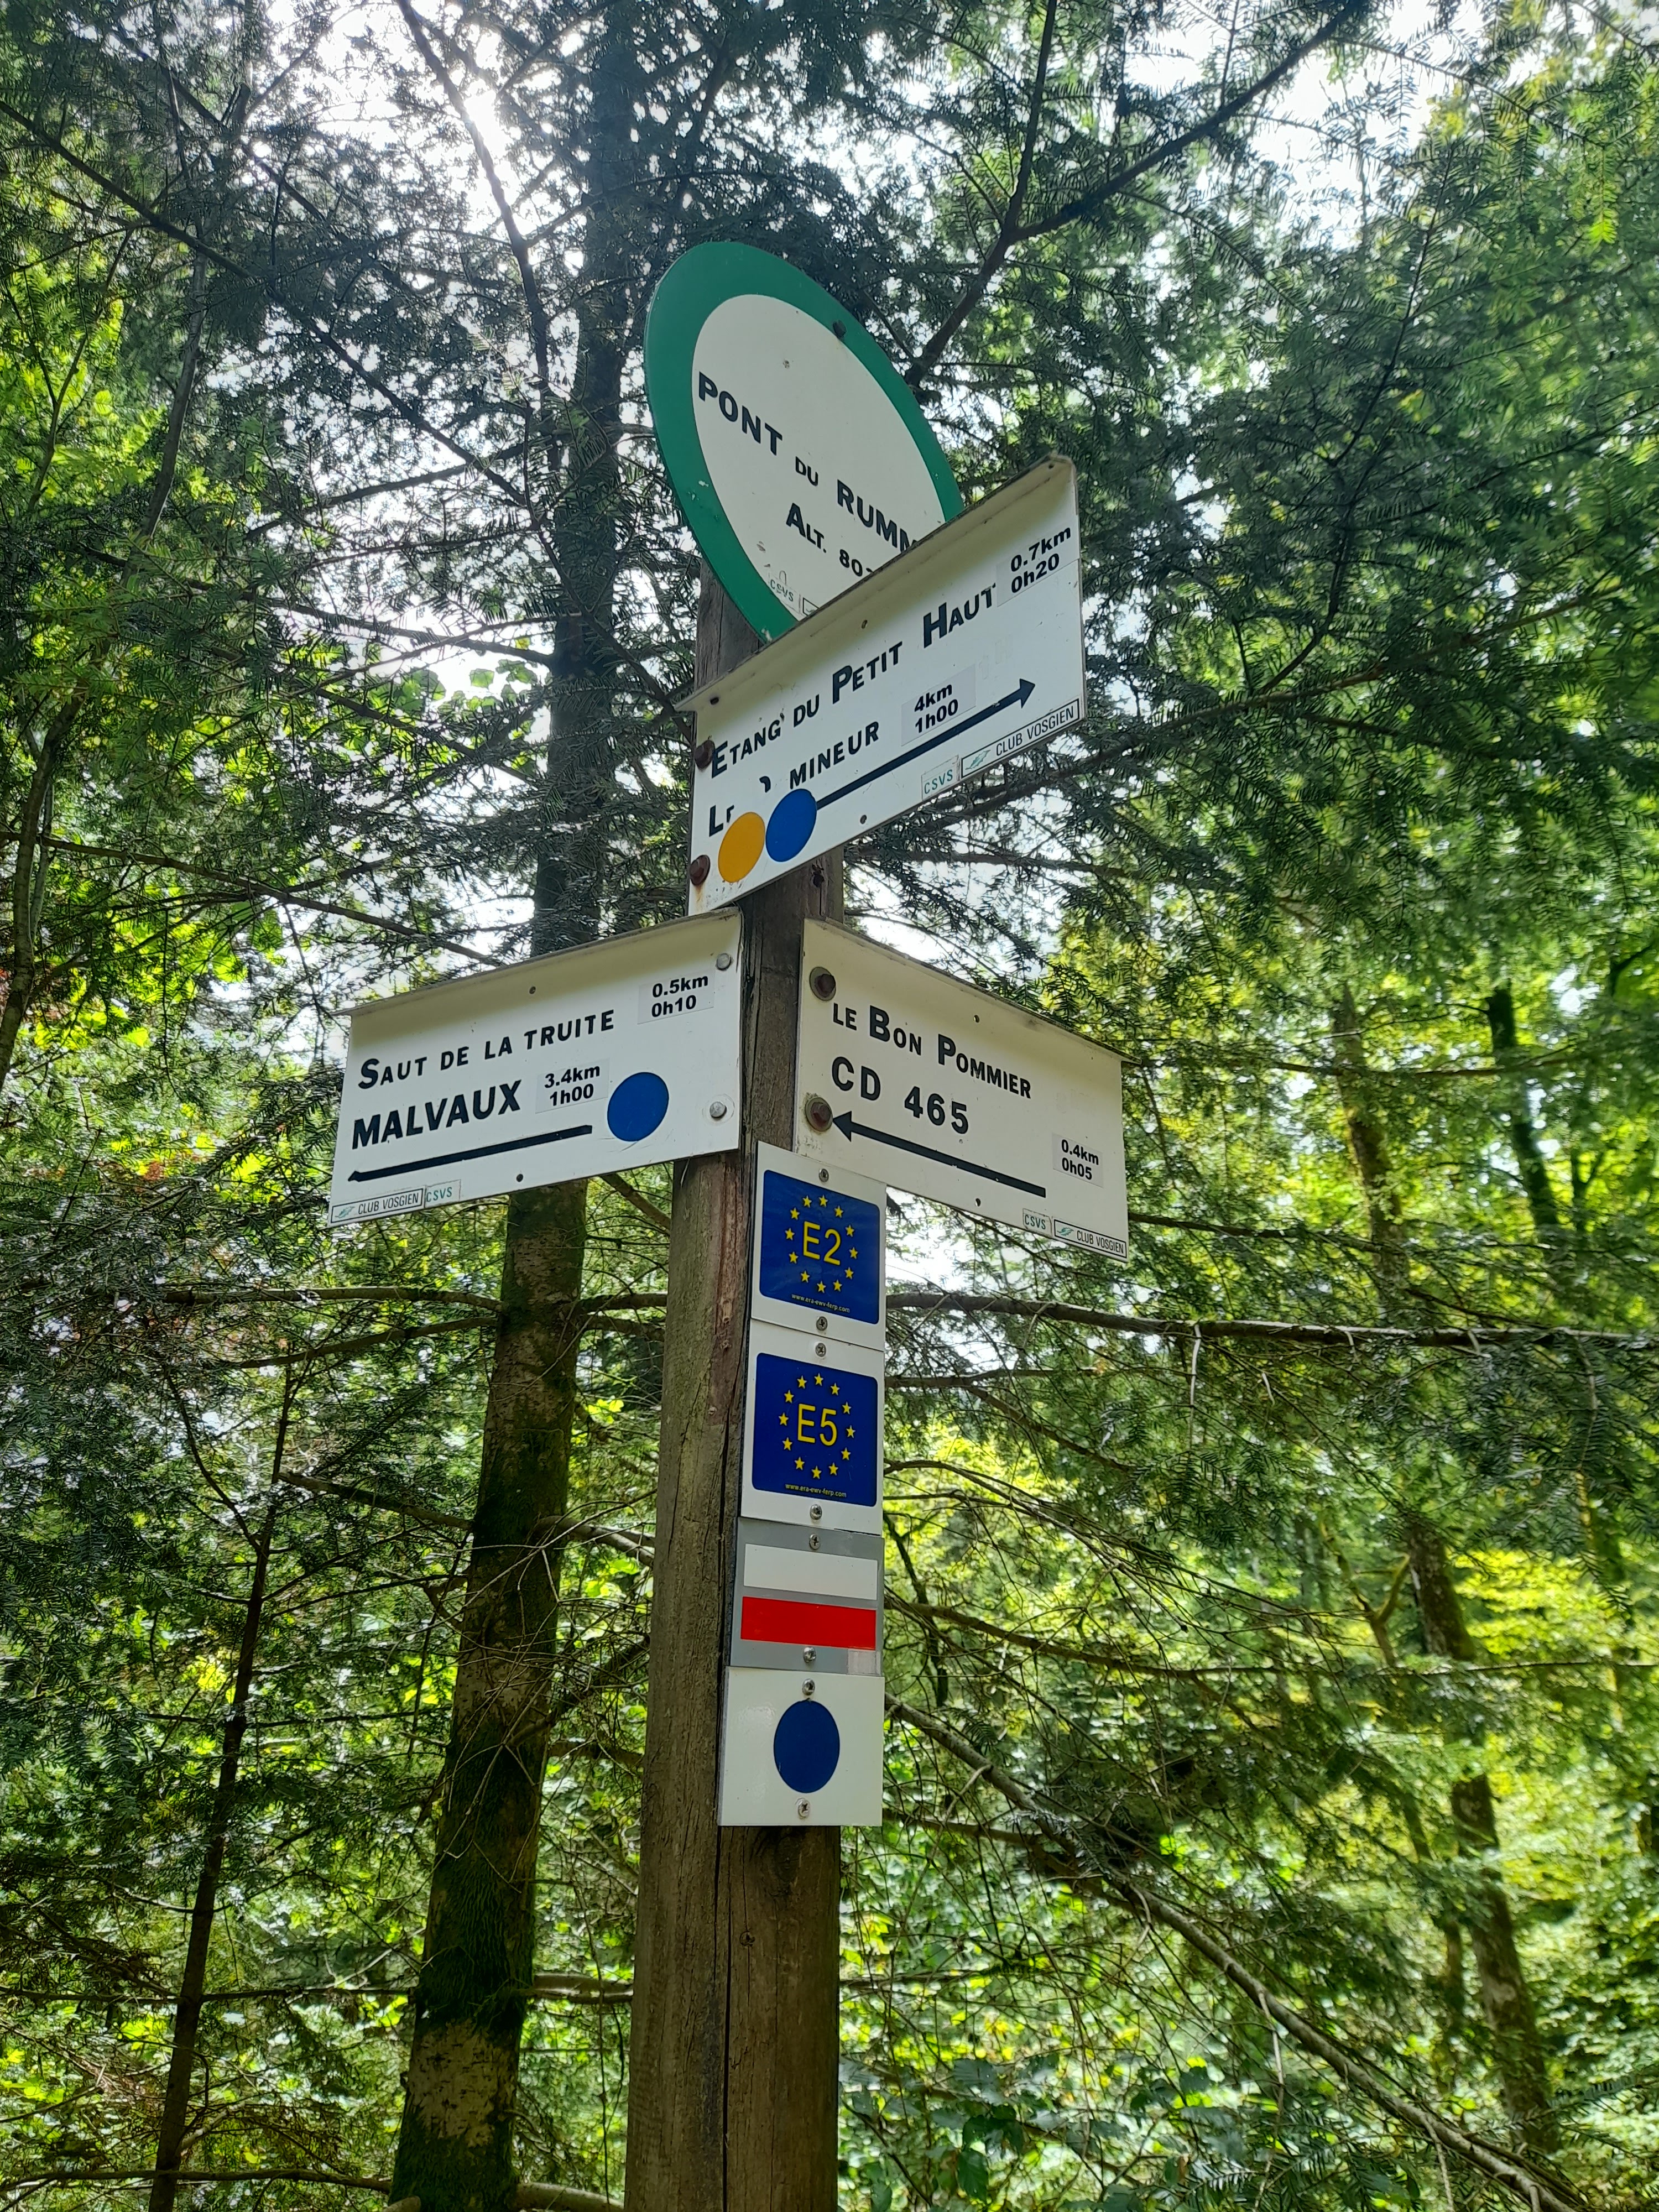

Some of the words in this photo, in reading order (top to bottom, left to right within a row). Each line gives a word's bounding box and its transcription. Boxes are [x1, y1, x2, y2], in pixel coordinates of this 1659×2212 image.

[698, 372, 782, 456] PONT
[795, 456, 818, 487] DU
[786, 502, 827, 554] ALT.
[839, 549, 874, 577] 80
[1011, 528, 1071, 572] 0.7km
[1011, 553, 1060, 593] 0h20
[711, 719, 781, 779] ETANG
[794, 694, 820, 728] DU
[832, 641, 902, 705] PETIT
[923, 582, 997, 649] HAUT
[914, 685, 952, 712] 4km
[915, 698, 958, 733] 1h00
[996, 733, 1023, 757] CLUB
[1027, 706, 1074, 740] VOSGIEN
[790, 721, 879, 790] MINEUR
[924, 769, 953, 794] CSVS
[652, 975, 708, 998] 0.5km
[651, 995, 697, 1018] 0h10
[358, 1058, 427, 1089] SAUT
[440, 1046, 469, 1071] DE
[484, 1036, 513, 1060] LA
[524, 1009, 614, 1050] TRUITE
[833, 1003, 857, 1031] LE
[869, 1005, 922, 1056] BON
[938, 1033, 1031, 1099] POMMIER
[544, 1064, 601, 1089] 3.4km
[550, 1083, 594, 1107] 1h00
[832, 1056, 881, 1101] CD
[904, 1086, 969, 1134] 465
[352, 1079, 521, 1150] MALVAUX
[1061, 1139, 1099, 1165] 0.4km
[1062, 1157, 1092, 1180] 0h05
[358, 1201, 379, 1214] CLUB
[383, 1193, 419, 1209] VOSGIEN
[426, 1187, 452, 1202] CSVS
[1025, 1214, 1046, 1230] CSVS
[803, 1221, 841, 1266] E2
[1077, 1230, 1094, 1244] CLUB
[1096, 1237, 1124, 1254] VOSGIEN
[797, 1403, 837, 1447] E5
